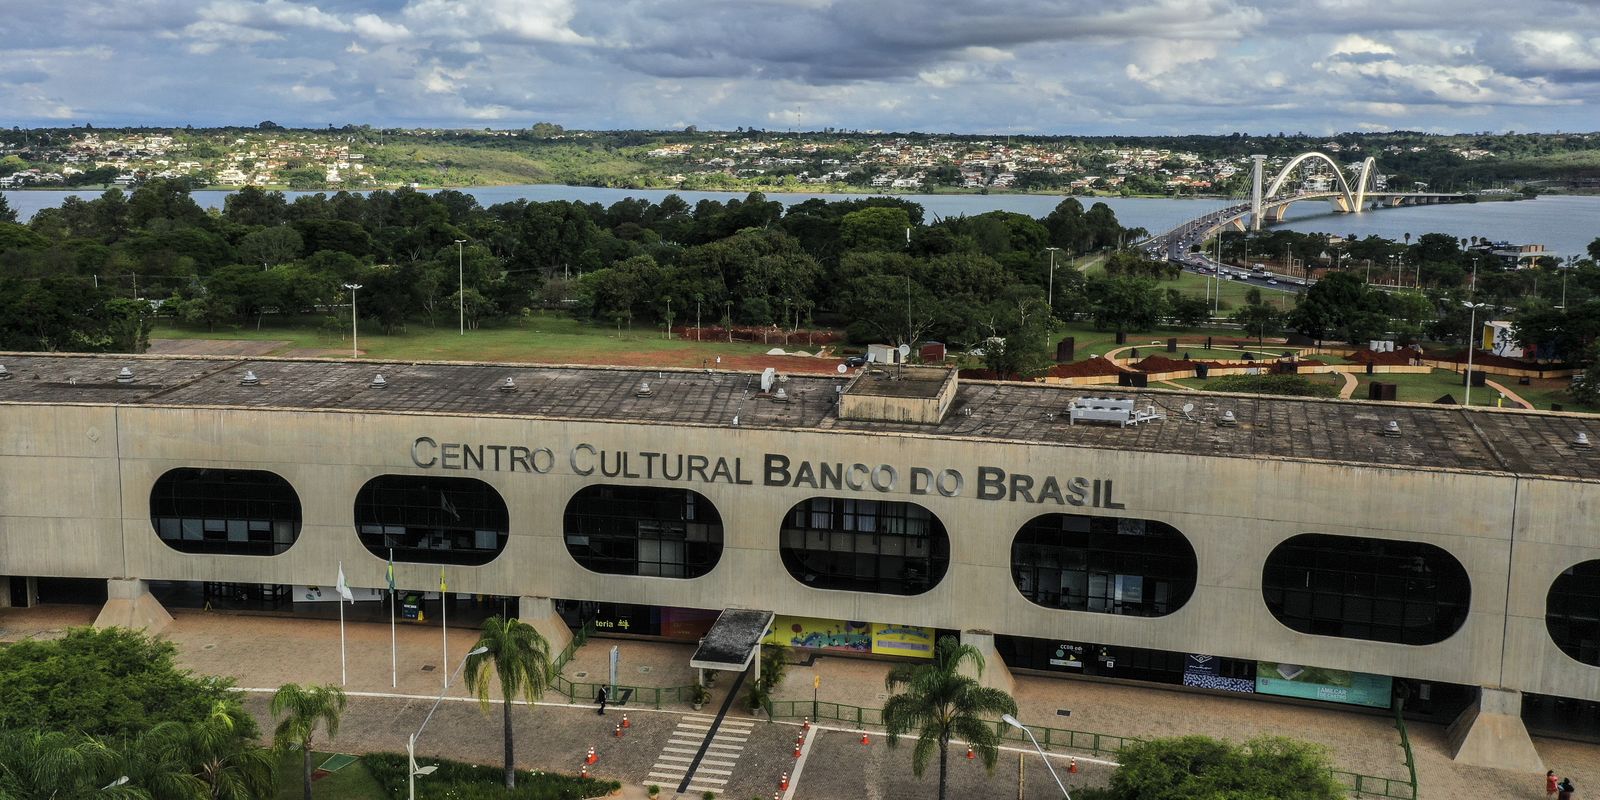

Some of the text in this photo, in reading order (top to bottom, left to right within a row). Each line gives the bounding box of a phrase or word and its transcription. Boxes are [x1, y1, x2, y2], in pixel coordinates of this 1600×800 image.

[411, 436, 1126, 510] CENTRO CULTURAL BANCO DO BRASIL
